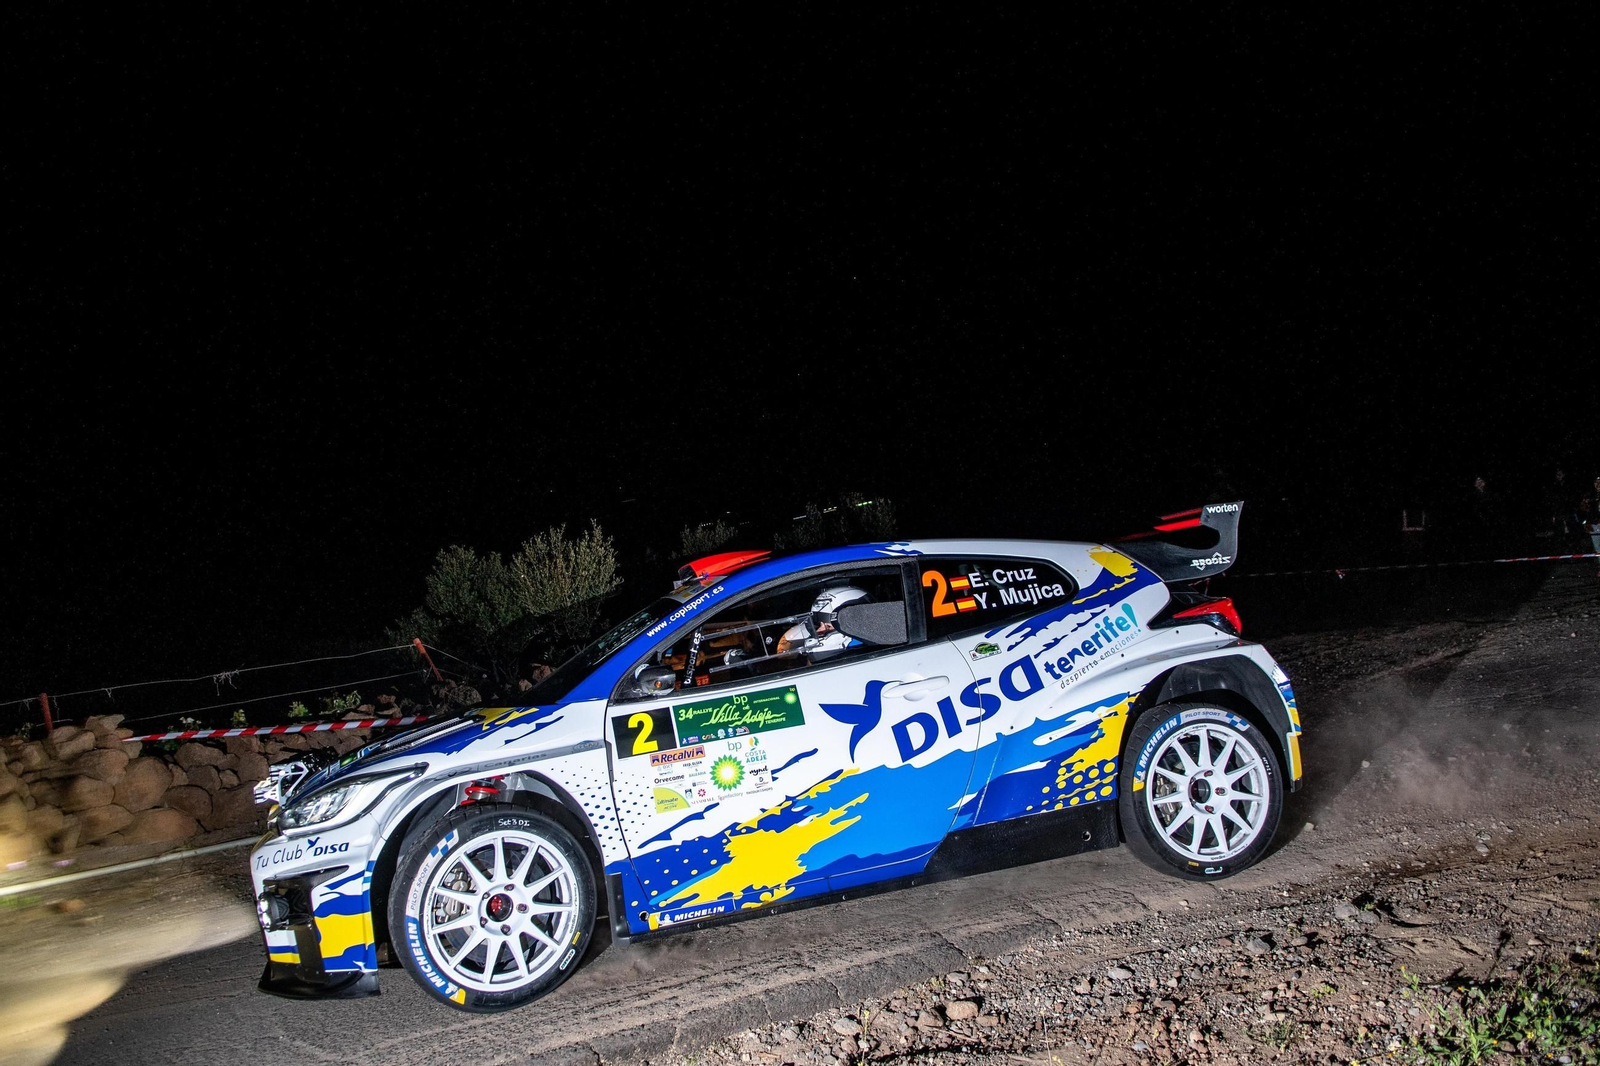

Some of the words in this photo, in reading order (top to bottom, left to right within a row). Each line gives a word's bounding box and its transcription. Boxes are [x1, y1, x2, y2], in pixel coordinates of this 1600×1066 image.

[1206, 503, 1239, 514] worten
[968, 572, 989, 588] E.
[992, 567, 1037, 584] Cruz
[922, 570, 957, 618] 2
[973, 592, 997, 610] Y.
[999, 583, 1065, 605] Mujica
[646, 584, 724, 638] www.copisport.es
[1060, 660, 1099, 690] despierta
[1099, 629, 1139, 660] emociones
[692, 707, 713, 715] RALLYE
[733, 694, 748, 706] bp
[678, 707, 693, 721] 34
[700, 702, 742, 727] Villa
[628, 712, 659, 755] 2
[1139, 717, 1178, 768] MICHELIN
[1184, 711, 1201, 719] PILOT
[660, 748, 695, 763] Recalvi
[727, 741, 742, 752] bp
[745, 749, 767, 758] COSTA
[746, 755, 767, 763] ADEJE
[256, 854, 270, 871] Tu
[272, 844, 303, 865] Club
[415, 862, 431, 887] SPORT
[410, 887, 421, 912] PILOT
[674, 905, 725, 922] MICHELIN
[407, 921, 446, 989] MICHELIN
